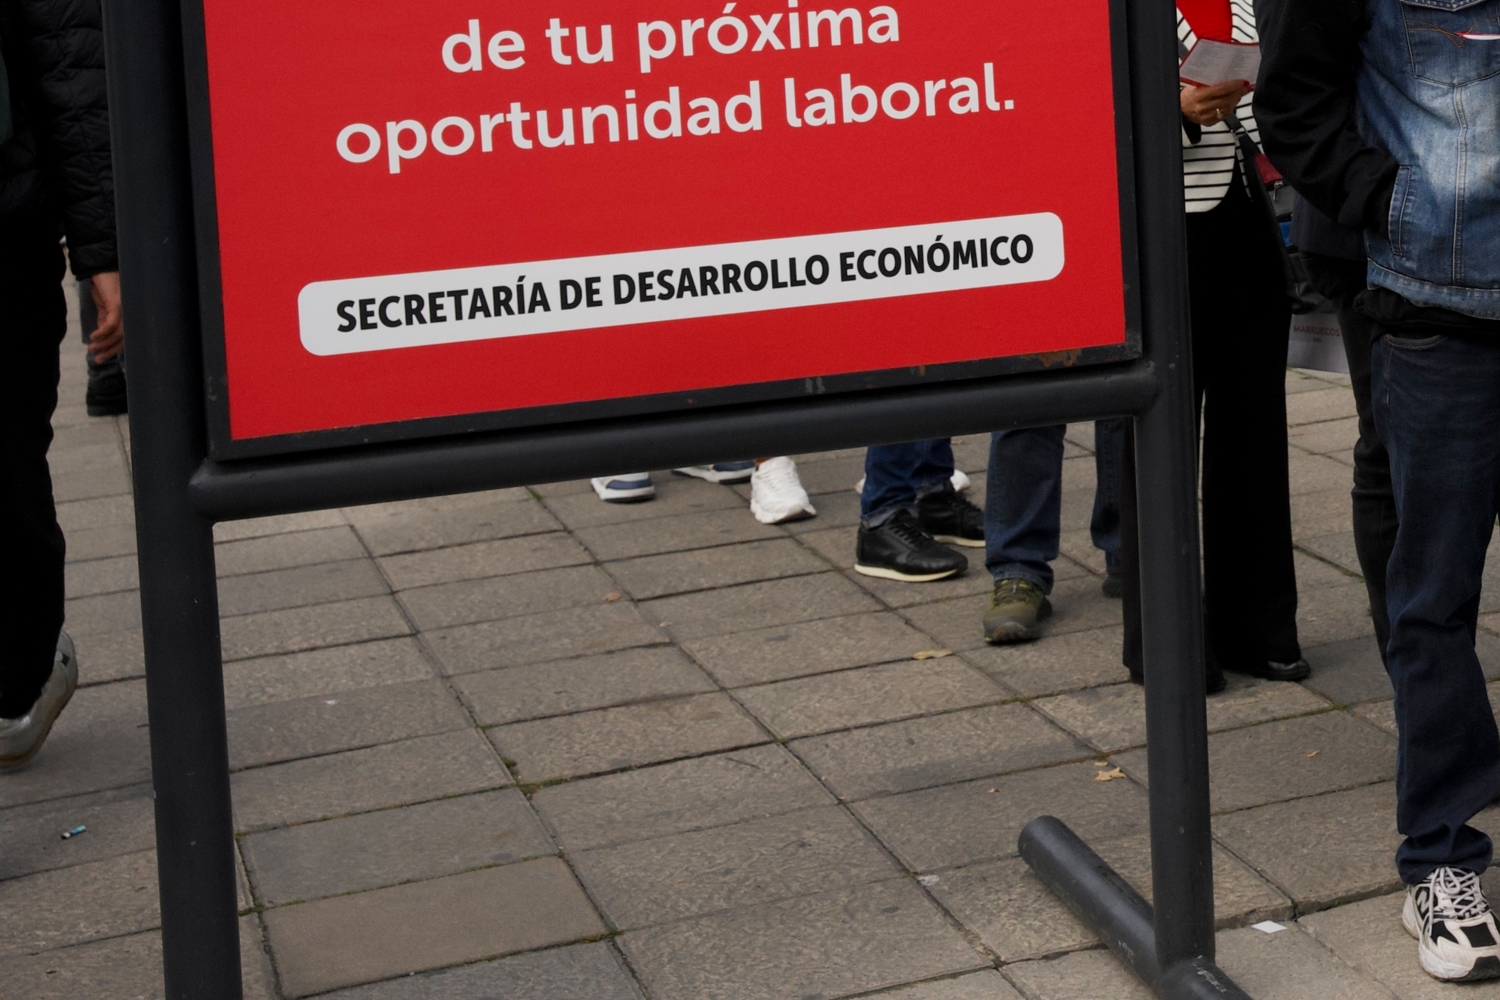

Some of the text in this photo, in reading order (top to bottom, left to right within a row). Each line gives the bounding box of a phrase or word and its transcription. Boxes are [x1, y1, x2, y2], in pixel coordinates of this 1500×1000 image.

[441, 19, 526, 74] de
[545, 17, 615, 66] tu
[336, 63, 1015, 175] oportunidad laboral.
[336, 234, 1034, 333] SECRETARÍA DE DESARROLLO ECONÓMICO
[1293, 325, 1340, 337] MARRUECOS
